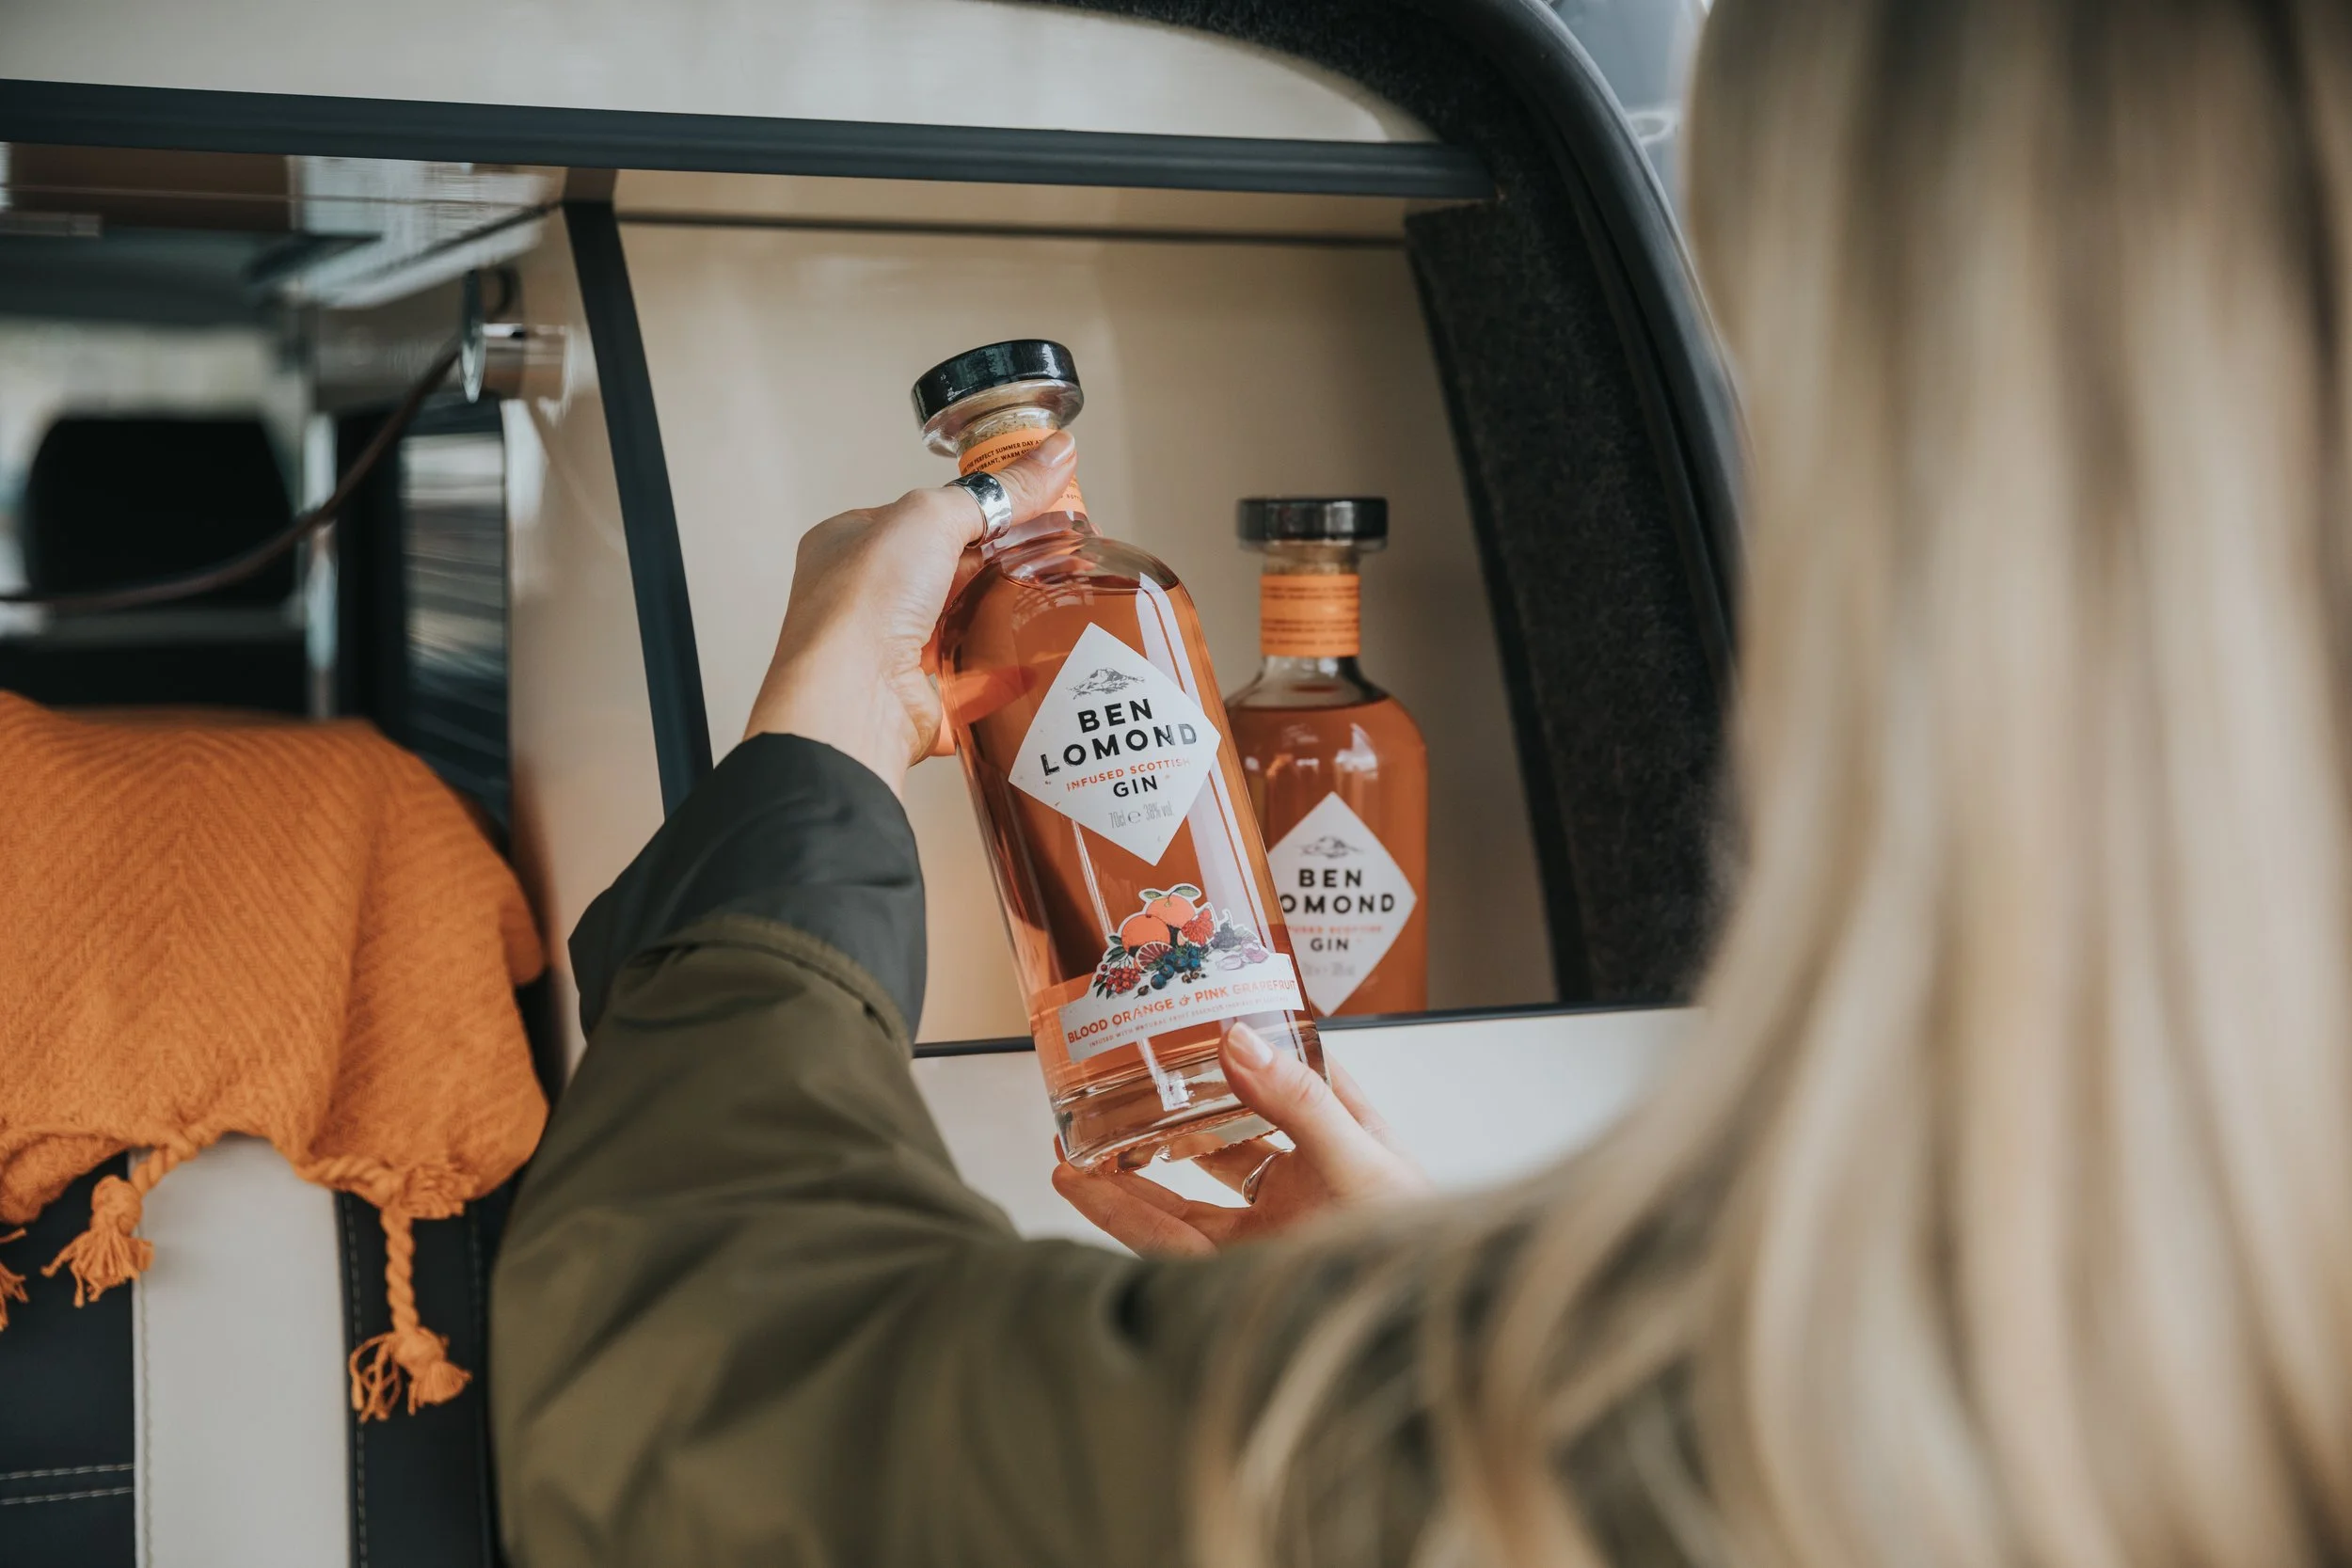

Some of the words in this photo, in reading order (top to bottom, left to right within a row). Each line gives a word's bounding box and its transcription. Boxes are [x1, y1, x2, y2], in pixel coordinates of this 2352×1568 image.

[974, 451, 994, 466] PERFECT
[995, 442, 1021, 454] SUMMER
[977, 458, 1001, 471] VIBRANT,
[1001, 451, 1021, 461] WARM
[1077, 698, 1152, 734] BEN
[1040, 723, 1198, 777] LOMOND
[1066, 768, 1124, 792] INFUSED
[1130, 758, 1191, 775] SCOTTISH
[1113, 775, 1158, 798] GIN
[1298, 868, 1362, 888] BEN
[1279, 894, 1395, 914] OMOND
[1311, 937, 1349, 952] GIN
[1067, 1019, 1108, 1044] BLOOD
[1112, 998, 1175, 1026] ORANGE
[1194, 986, 1229, 1003] PINK
[1232, 979, 1295, 995] GRAPEFRUIT
